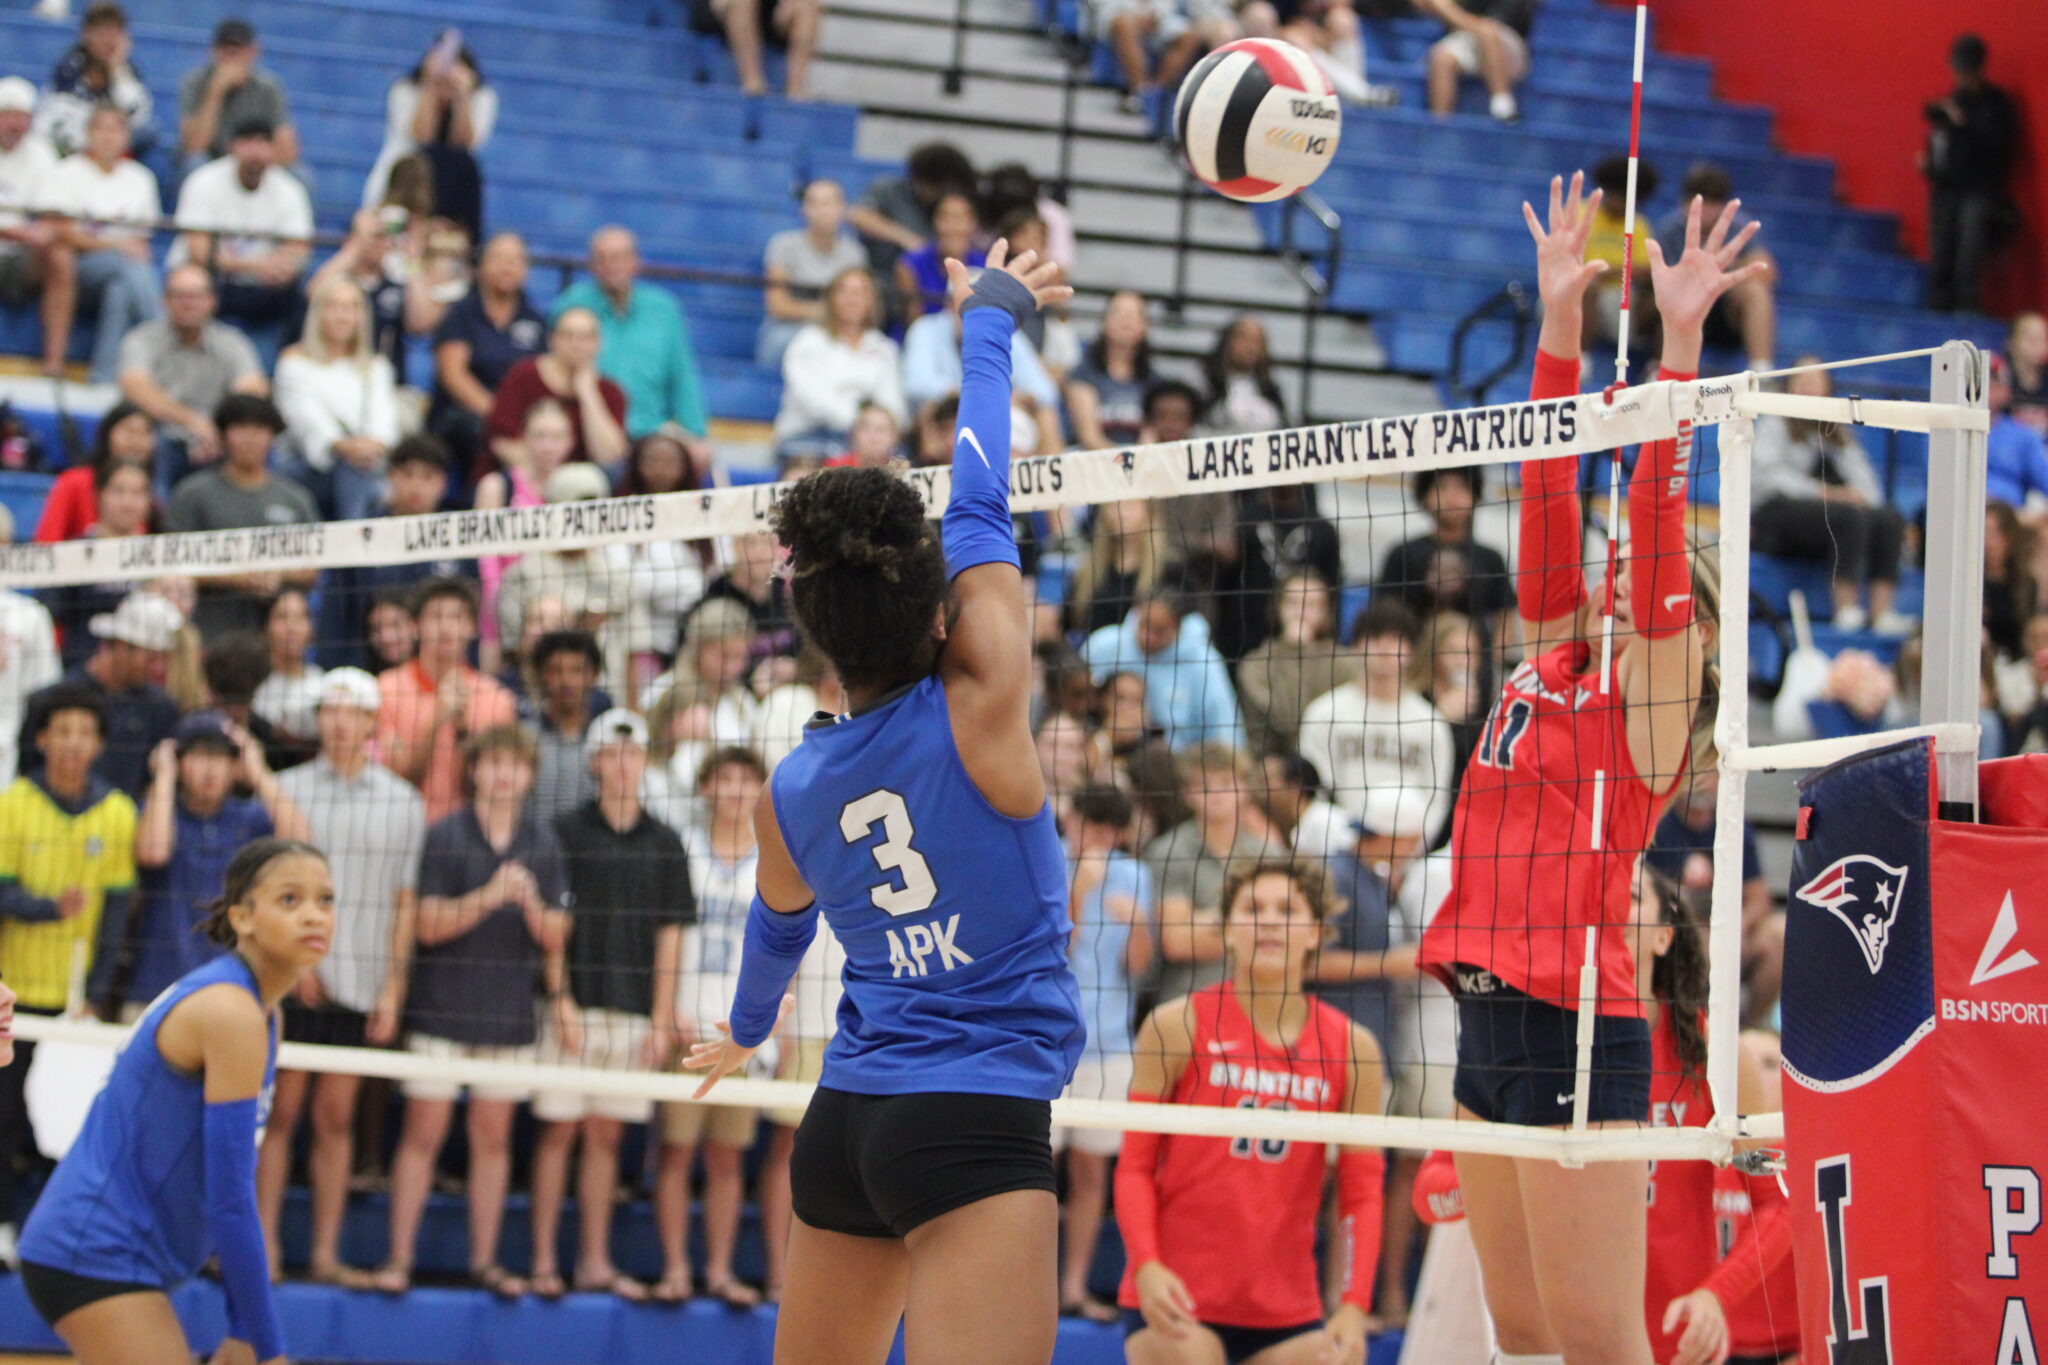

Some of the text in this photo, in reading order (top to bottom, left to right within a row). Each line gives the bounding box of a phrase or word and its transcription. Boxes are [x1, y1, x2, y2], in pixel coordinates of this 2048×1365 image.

[1705, 384, 1733, 397] Senoh
[1187, 400, 1577, 480] LAKE BRANTLEY PATRIOTS
[404, 499, 655, 551] LAKE BRANTLEY PATRIOTS
[838, 788, 939, 918] 3
[885, 913, 975, 979] APK
[1208, 1061, 1331, 1103] BRANTLEY
